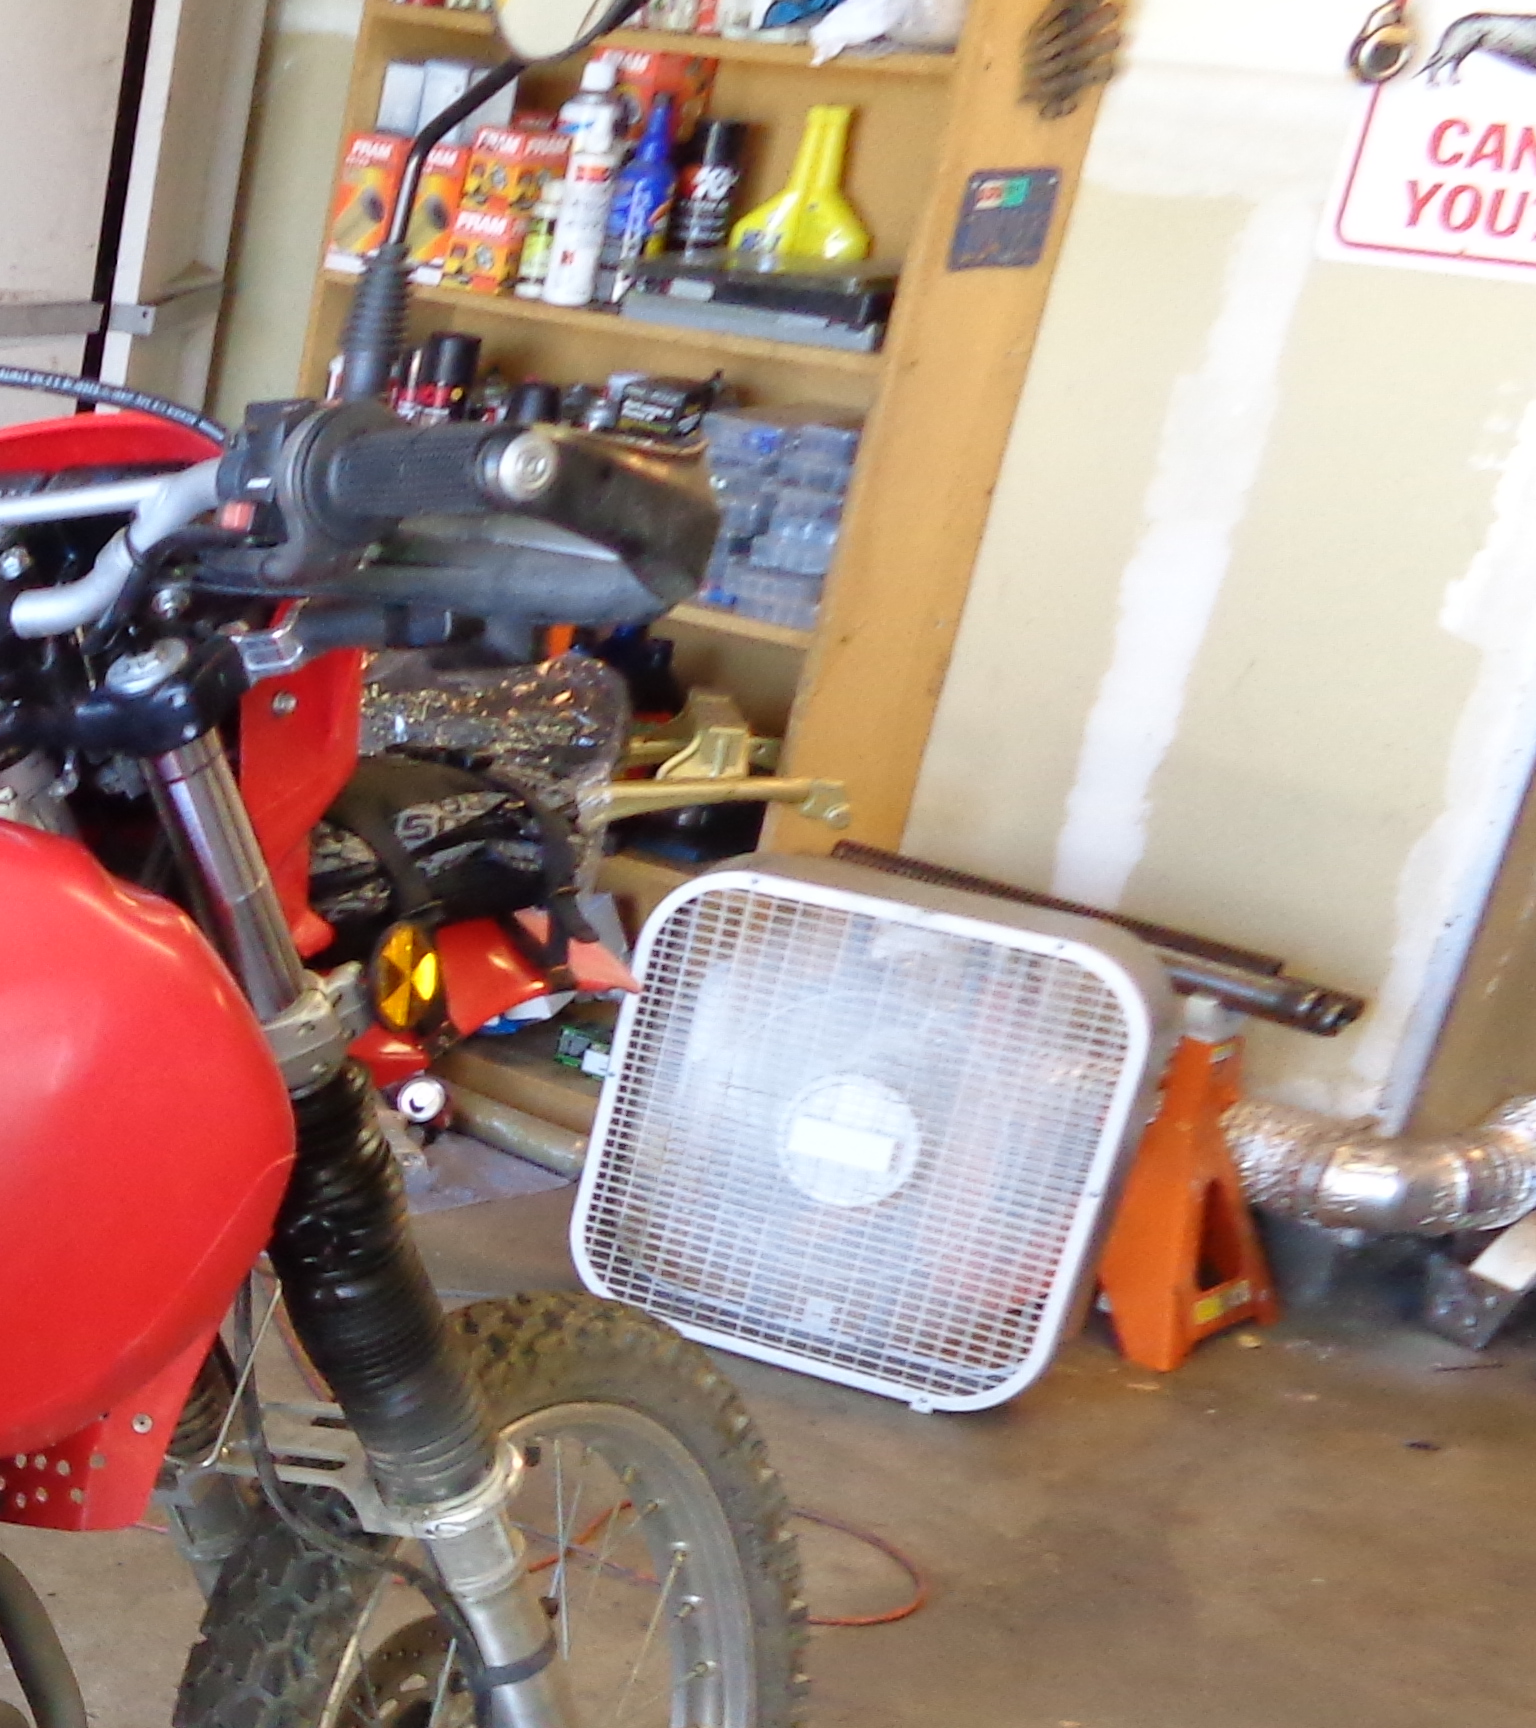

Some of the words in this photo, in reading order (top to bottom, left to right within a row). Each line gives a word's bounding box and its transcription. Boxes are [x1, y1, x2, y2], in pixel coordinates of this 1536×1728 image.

[350, 138, 394, 160] FRAM
[474, 129, 522, 154] FRAM
[426, 147, 459, 168] AM
[1405, 180, 1536, 238] YOU
[454, 211, 508, 236] FRAM
